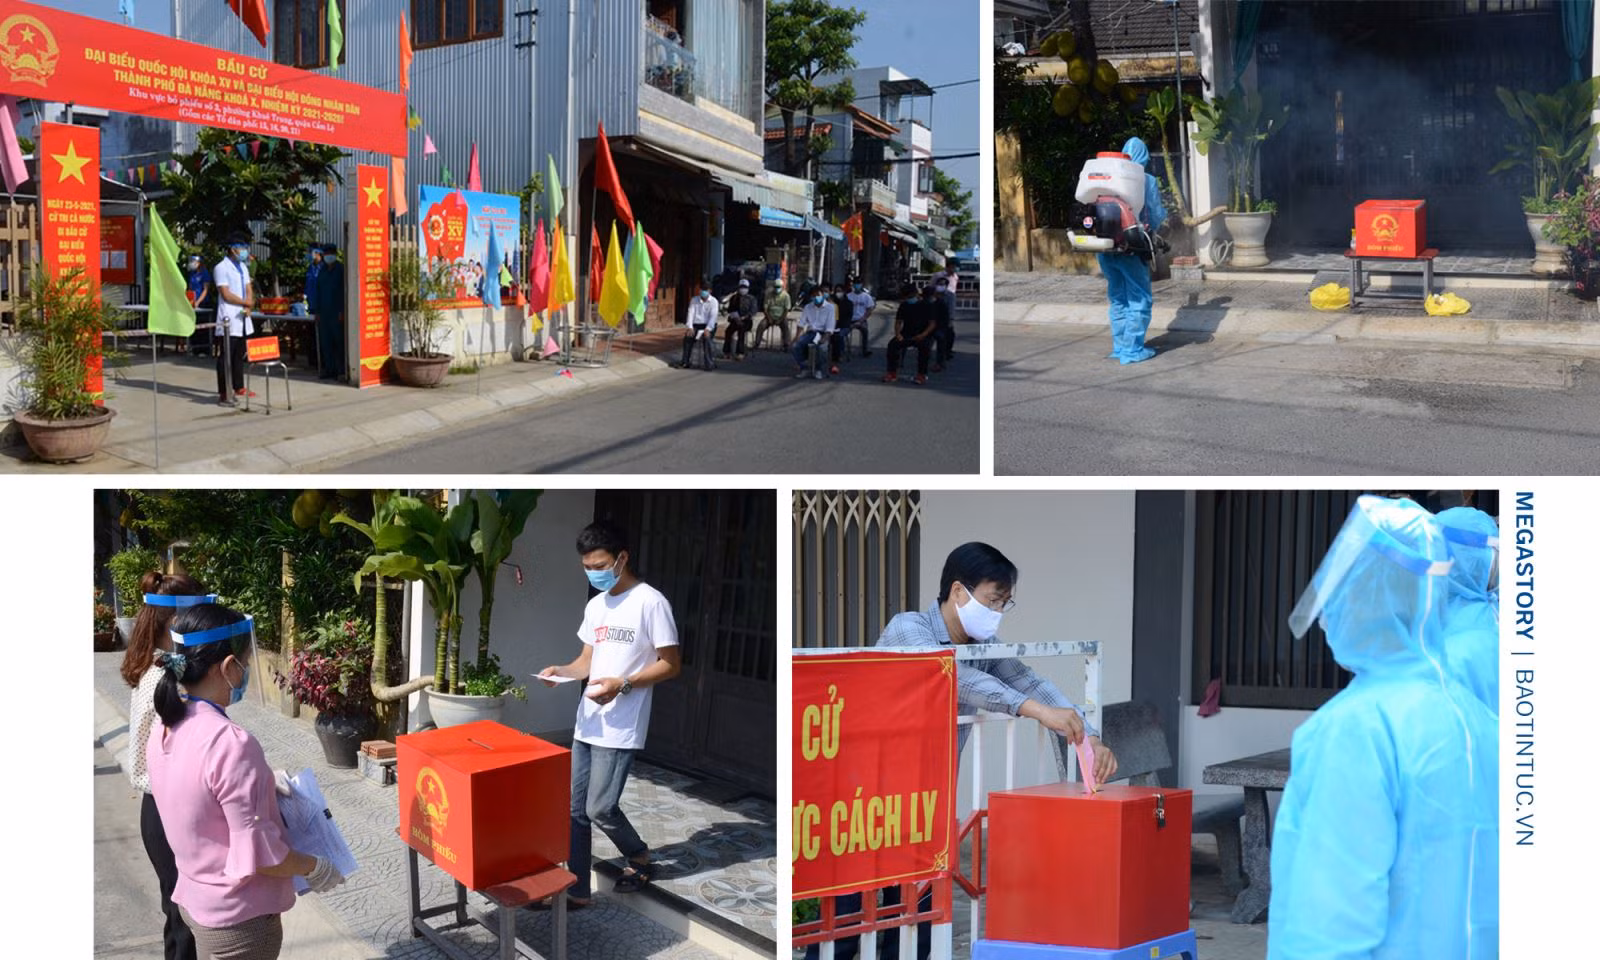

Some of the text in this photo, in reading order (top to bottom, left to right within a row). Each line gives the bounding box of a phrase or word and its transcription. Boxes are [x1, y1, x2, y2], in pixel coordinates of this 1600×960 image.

[85, 48, 105, 64] ĐẠI
[138, 59, 167, 75] QUỐC
[170, 66, 187, 80] HỘI
[218, 76, 231, 88] XV
[234, 78, 245, 92] VÀ
[114, 70, 151, 87] THÀNH
[154, 75, 175, 92] PHỐ
[250, 64, 268, 80] CỬ
[129, 87, 148, 99] Khu
[448, 226, 463, 236] XV
[607, 628, 635, 643] STUDIOS
[802, 684, 845, 761] CỬ
[830, 786, 902, 857] CÁCH
[909, 790, 938, 844] LY
[412, 825, 457, 864] HÒM PHIẾU
